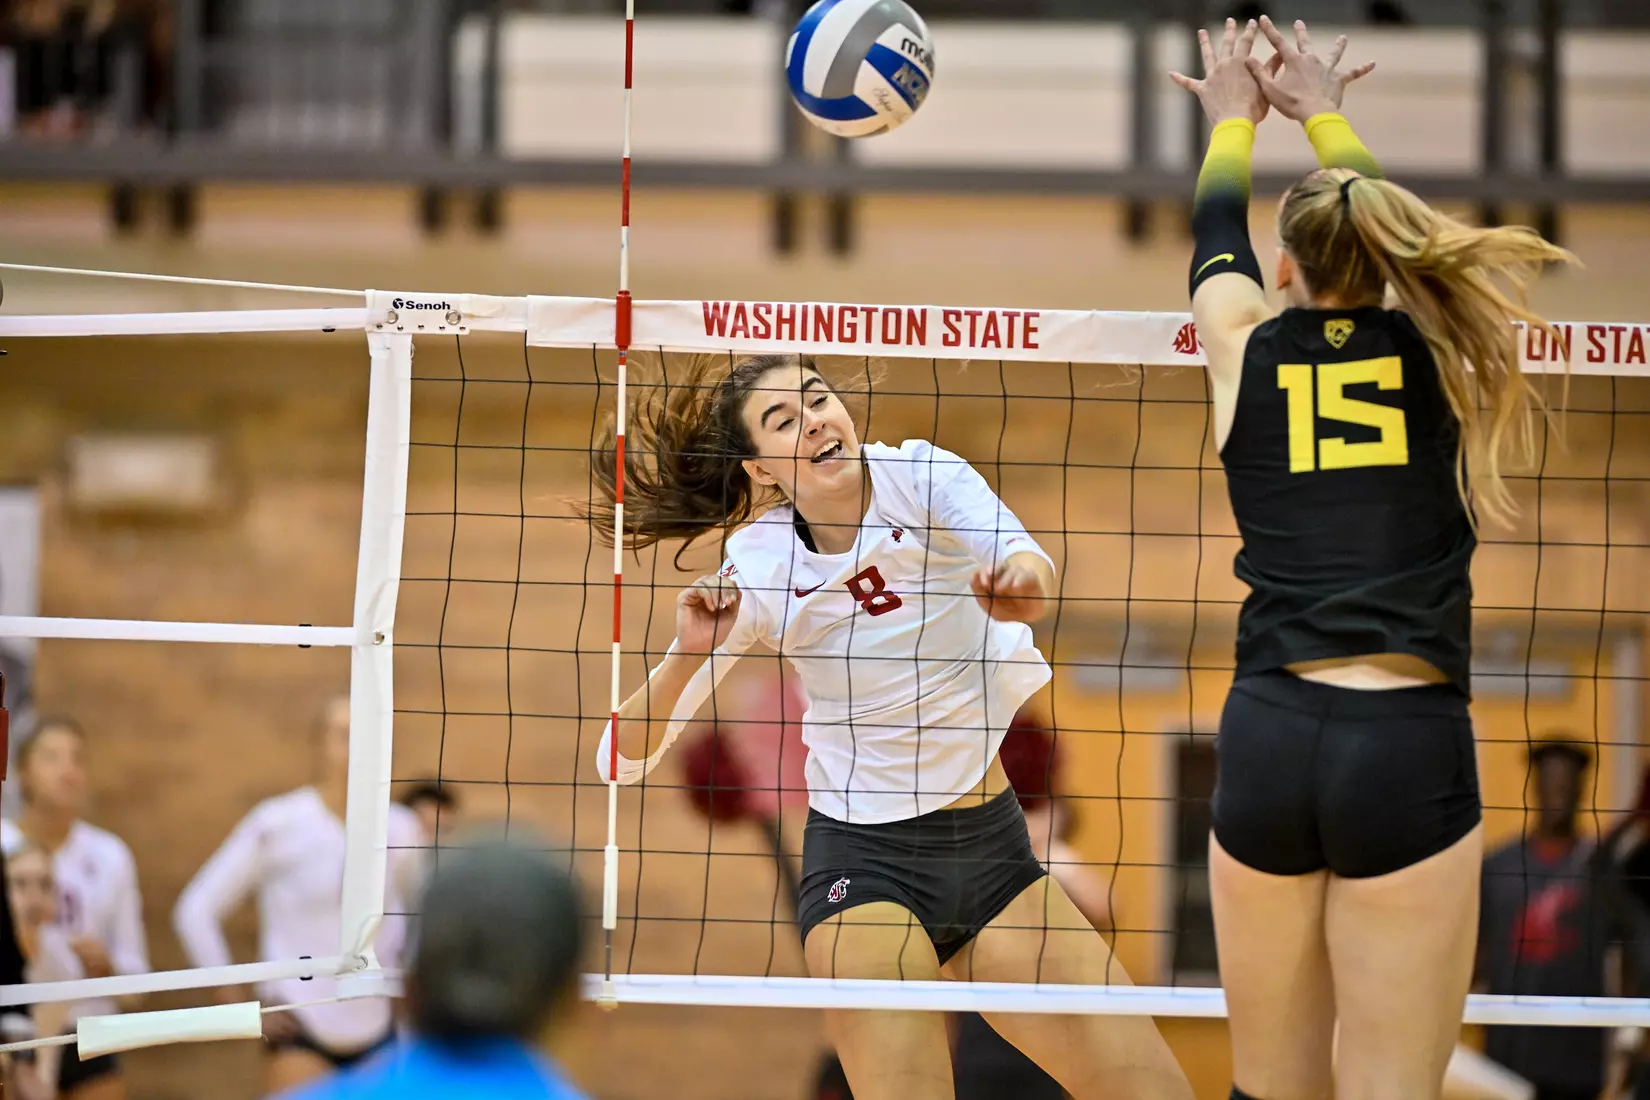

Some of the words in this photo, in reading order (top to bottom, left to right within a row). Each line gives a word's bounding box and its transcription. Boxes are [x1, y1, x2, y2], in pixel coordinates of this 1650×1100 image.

[405, 300, 451, 311] Senoh
[701, 301, 928, 347] WASHINGTON
[942, 308, 1040, 350] STATE
[1586, 325, 1650, 364] STA
[1277, 355, 1409, 474] 15
[842, 565, 903, 617] 8
